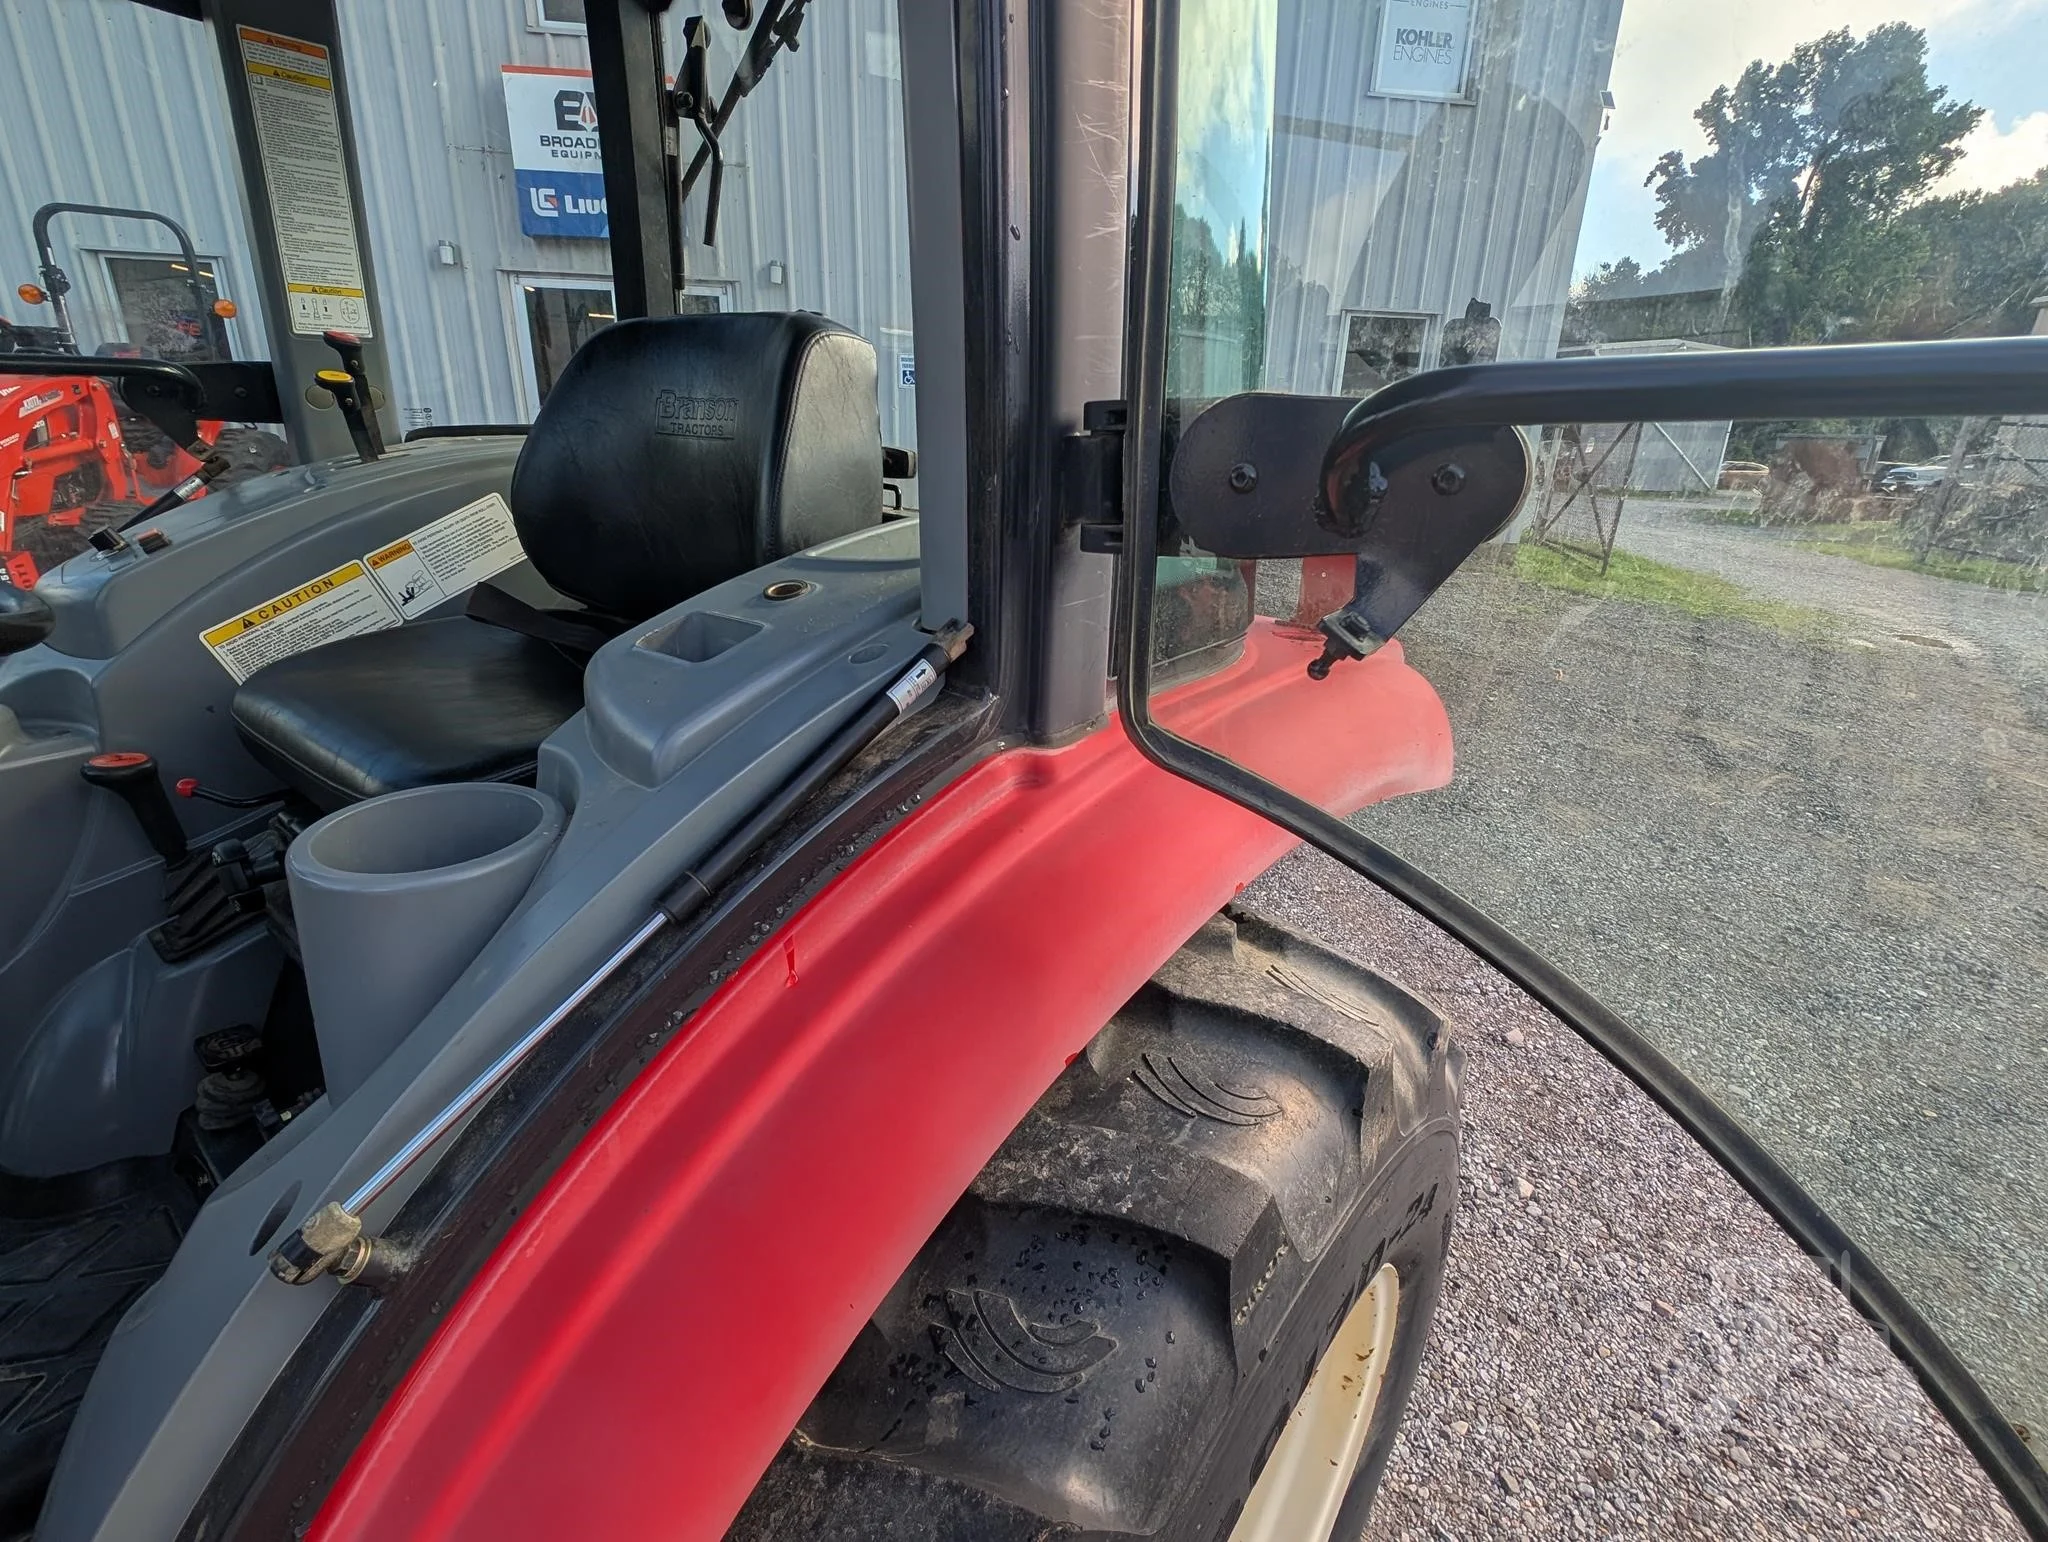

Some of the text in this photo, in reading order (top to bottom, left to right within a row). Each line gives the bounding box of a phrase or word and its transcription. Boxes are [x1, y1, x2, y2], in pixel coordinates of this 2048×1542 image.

[1395, 28, 1453, 49] KOHLER
[1393, 45, 1453, 65] ENGINES
[540, 135, 600, 150] BROAD
[670, 422, 724, 436] TRACTORS
[377, 542, 411, 563] WARNING
[258, 578, 334, 620] CAUTION
